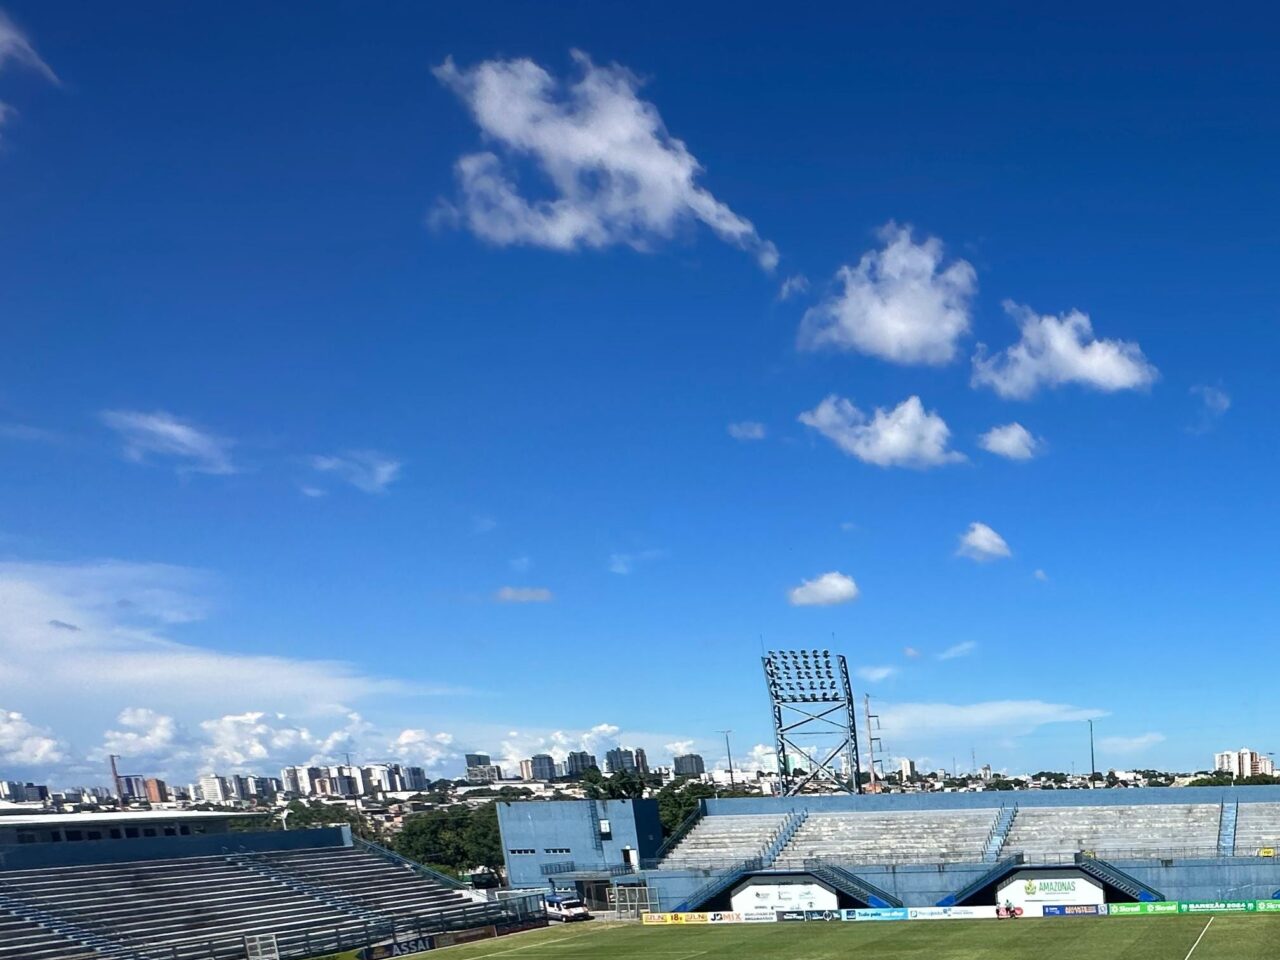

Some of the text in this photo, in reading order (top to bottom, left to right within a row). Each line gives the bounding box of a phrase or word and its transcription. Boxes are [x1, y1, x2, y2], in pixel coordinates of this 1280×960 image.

[1039, 881, 1076, 892] AMAZONAS
[1119, 904, 1140, 913] Sicredi
[1155, 903, 1177, 911] Sicredi
[391, 938, 432, 957] ASSAÍ
